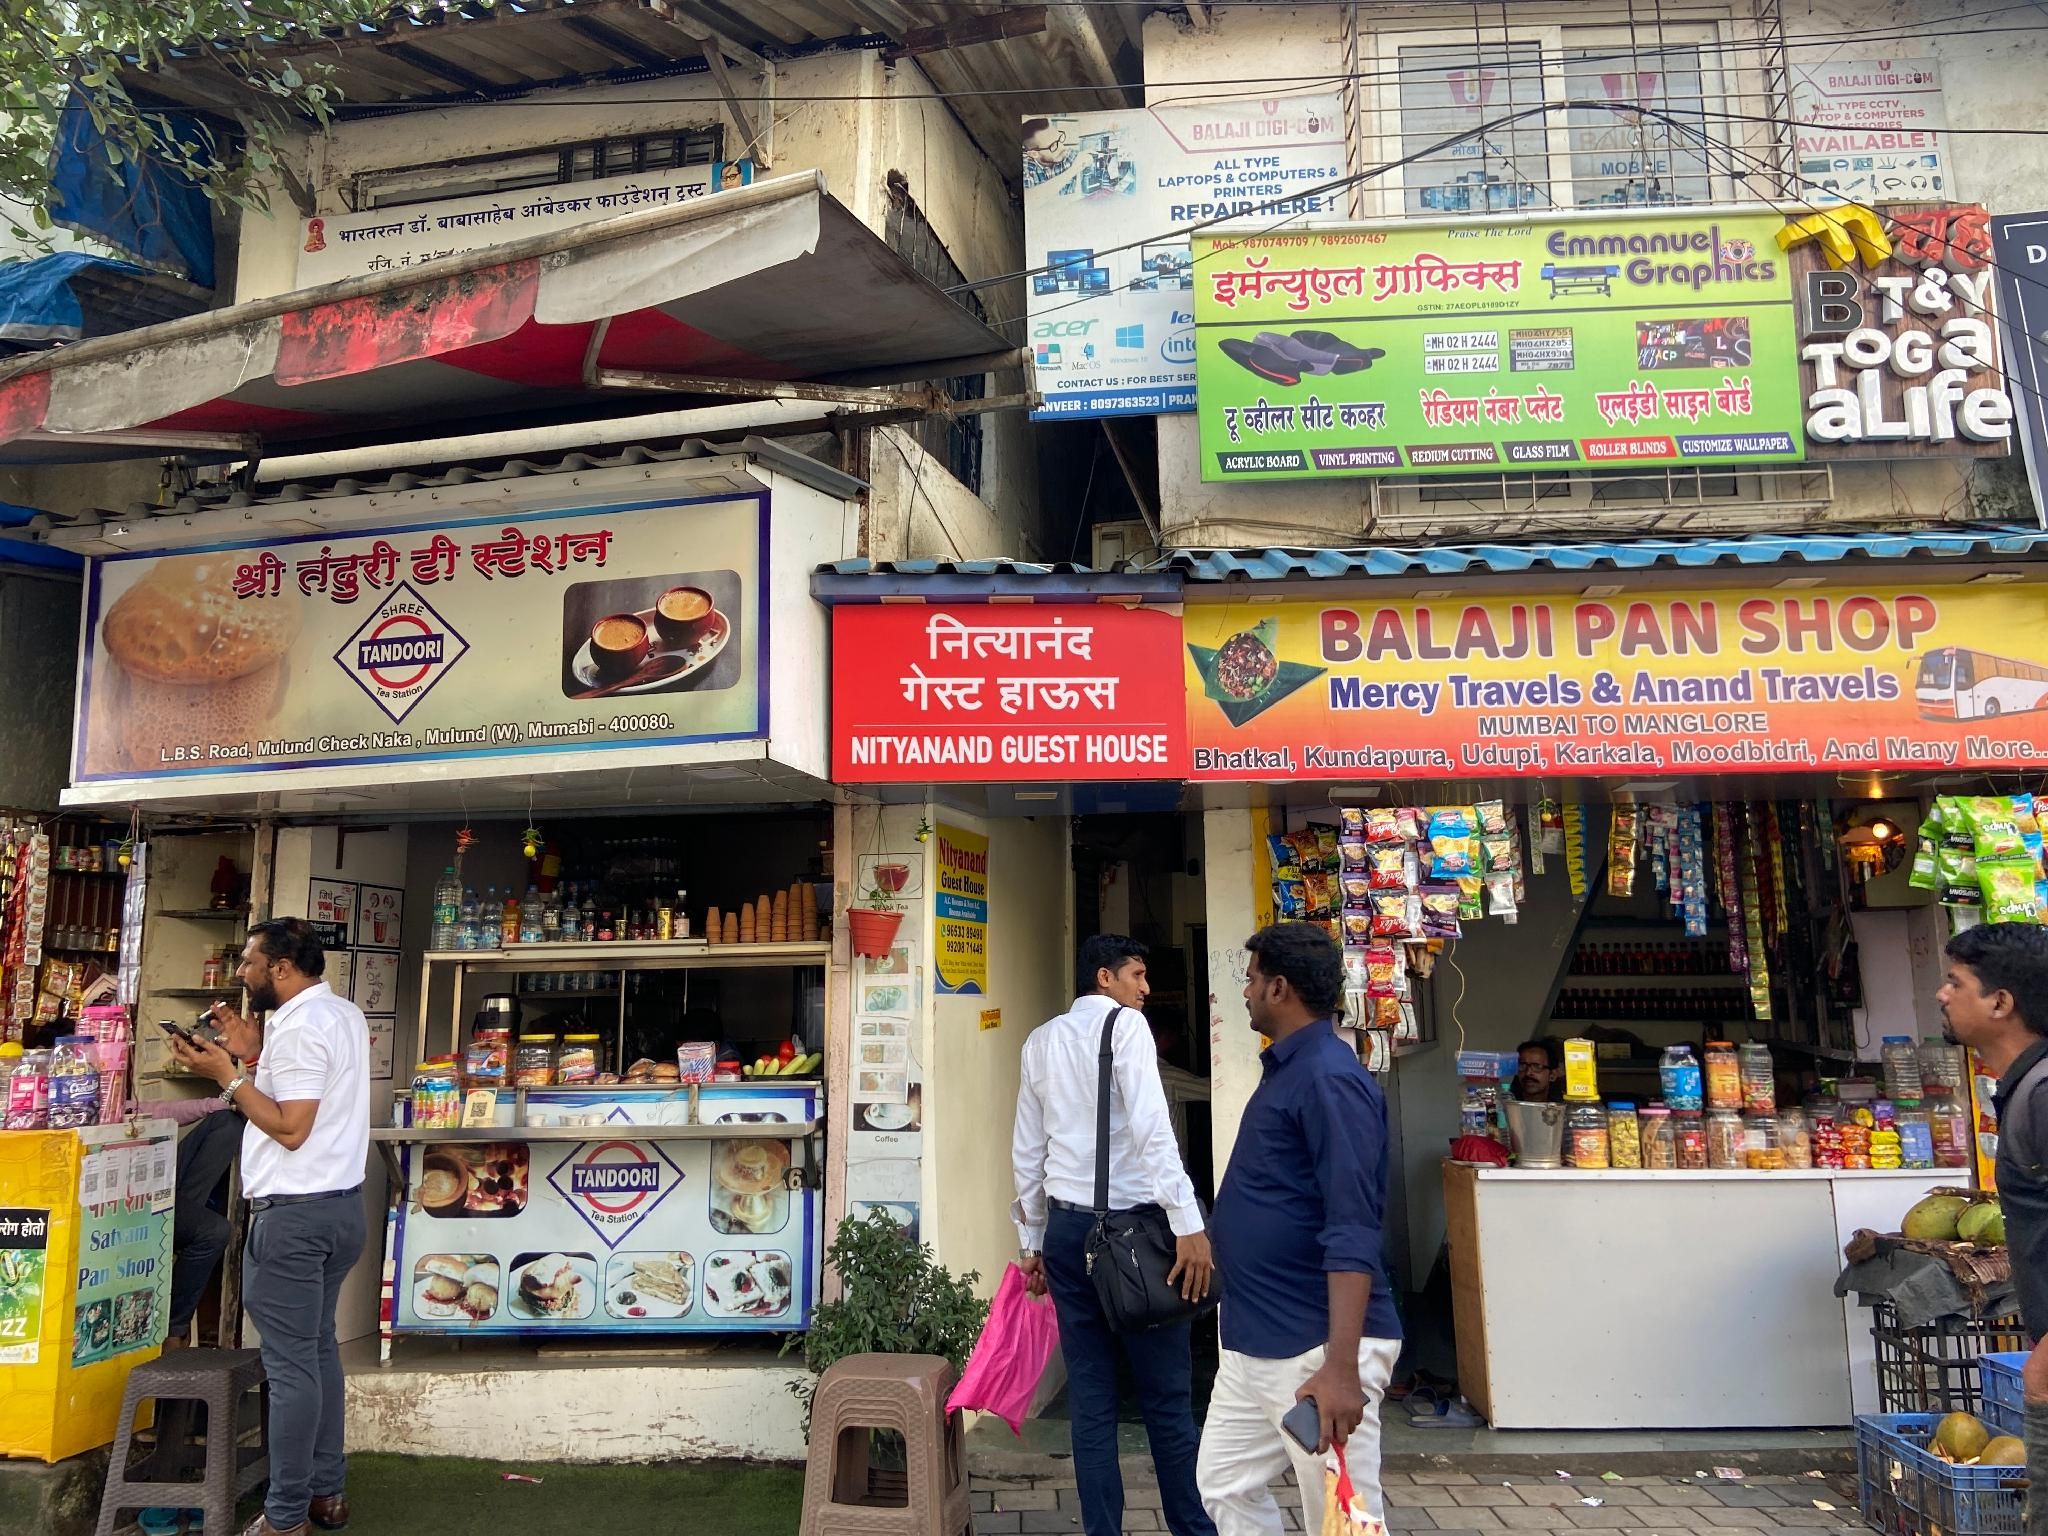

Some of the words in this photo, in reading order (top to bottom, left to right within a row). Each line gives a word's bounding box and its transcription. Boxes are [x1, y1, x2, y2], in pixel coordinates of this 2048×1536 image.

[1829, 75, 1871, 88] BALAJI
[1838, 101, 1866, 110] TYPE
[1845, 112, 1852, 120] &
[1854, 109, 1926, 120] COMPUTERS
[1193, 121, 1250, 142] BALAJI
[1796, 132, 1926, 152] AVAILABLE
[1214, 160, 1240, 170] ALL
[1244, 156, 1280, 168] TYPE
[1158, 174, 1222, 188] LAPTOPS
[1226, 174, 1234, 184] &
[1238, 168, 1324, 182] COMPUTERS
[1328, 167, 1338, 177] &
[1214, 184, 1282, 198] PRINTERS
[339, 222, 404, 242] भारतरत्न
[408, 214, 431, 233] डॉ.
[437, 204, 516, 230] बाबासाहेब
[520, 196, 592, 218] आंबेडकर
[1171, 201, 1254, 222] REPAIR
[1260, 196, 1322, 216] HERE
[1212, 239, 1240, 250] Mob:
[1242, 236, 1308, 250] 9870749709
[1321, 234, 1388, 246] 9892607467
[1448, 229, 1480, 239] Praise
[1484, 227, 1504, 238] The
[1507, 226, 1532, 236] Lord
[1545, 223, 1720, 258] Emmanuel
[1372, 252, 1523, 303] ग्राफिक्स
[1625, 255, 1777, 291] Graphics
[1034, 318, 1098, 338] acer
[1431, 338, 1444, 349] MH
[1446, 336, 1458, 348] 02
[1462, 336, 1468, 348] H
[1471, 334, 1496, 348] 2444
[1432, 360, 1445, 372] MH
[1447, 358, 1460, 370] 02
[1462, 358, 1468, 370] H
[1472, 356, 1497, 370] 2444
[1058, 378, 1103, 388] CONTACT
[1106, 377, 1118, 386] US
[1127, 376, 1146, 386] FOR
[1150, 374, 1174, 384] BEST
[1034, 401, 1081, 414] ANVEER
[1090, 395, 1160, 410] 8097363523
[1420, 388, 1479, 427] रेडियम
[1482, 386, 1521, 425] नंबर
[1524, 384, 1564, 423] प्लेट
[1596, 380, 1660, 426] एलईडी
[1662, 389, 1711, 424] साइन
[1714, 376, 1752, 416] बोर्ड
[1243, 398, 1296, 434] व्हीलर
[1300, 396, 1334, 430] सीट
[1338, 402, 1387, 430] कव्हर
[1512, 446, 1544, 458] GLASS
[1546, 444, 1570, 457] FILM
[1589, 443, 1628, 456] ROLLER
[1630, 441, 1666, 455] BLINDS
[1682, 439, 1732, 453] CUSTOMIZE
[1734, 437, 1789, 450] WALLPAPER
[1226, 456, 1264, 470] ACRYLIC
[1266, 454, 1300, 468] BOARD
[1319, 453, 1349, 466] VINYL
[1350, 451, 1394, 464] PRINTING
[1412, 450, 1450, 464] REDIUM
[1451, 448, 1494, 461] CUTTING
[232, 551, 286, 600] श्री
[411, 534, 461, 587] टी
[472, 526, 614, 579] स्टेशन
[380, 602, 425, 620] SHREE
[926, 613, 1094, 662] नित्यानंद
[1321, 604, 1554, 662] BALAJI
[1575, 602, 1720, 657] PAN
[1738, 595, 1937, 655] SHOP
[361, 640, 442, 664] TANDOORI
[376, 686, 390, 700] Tea
[392, 684, 424, 700] Station
[900, 662, 986, 711] गेस्ट
[997, 676, 1120, 715] हाऊस
[1330, 676, 1439, 714] Mercy
[1449, 673, 1581, 708] Travels
[1592, 672, 1622, 704] &
[1632, 669, 1751, 704] Anand
[1761, 666, 1899, 701] Travels
[1478, 716, 1578, 738] MUMBAI
[1582, 714, 1616, 736] TO
[1624, 712, 1768, 734] MANGLORE
[160, 746, 204, 763] L.B.S.
[208, 743, 253, 760] Road,
[256, 738, 314, 758] Mulund
[318, 734, 368, 753] Check
[372, 731, 412, 749] Naka
[426, 728, 486, 746] Mulund
[490, 723, 523, 745] (W),
[528, 718, 595, 738] Mumabi
[608, 713, 674, 733] 400080.
[852, 735, 992, 765] NITYANAND
[1001, 734, 1080, 764] GUEST
[1086, 734, 1168, 763] HOUSE
[1194, 747, 1297, 771] Bhatkal,
[1304, 744, 1454, 772] Kundapura,
[1462, 742, 1548, 770] Udupi,
[1556, 741, 1664, 767] Karkala,
[1672, 738, 1816, 766] Moodbidri,
[1824, 738, 1878, 762] And
[1886, 736, 1958, 765] Many
[938, 837, 986, 875] Nityanand
[941, 871, 962, 892] Guest
[964, 875, 985, 896] House
[2000, 899, 2036, 917] Chips
[874, 1135, 899, 1144] Coffee
[575, 1169, 658, 1188] TANDOORI
[591, 1210, 605, 1222] Tea
[607, 1210, 638, 1224] Station
[21, 1218, 45, 1238] होतो
[90, 1226, 149, 1252] Satyam
[78, 1266, 110, 1290] Pan
[116, 1257, 155, 1280] Shop
